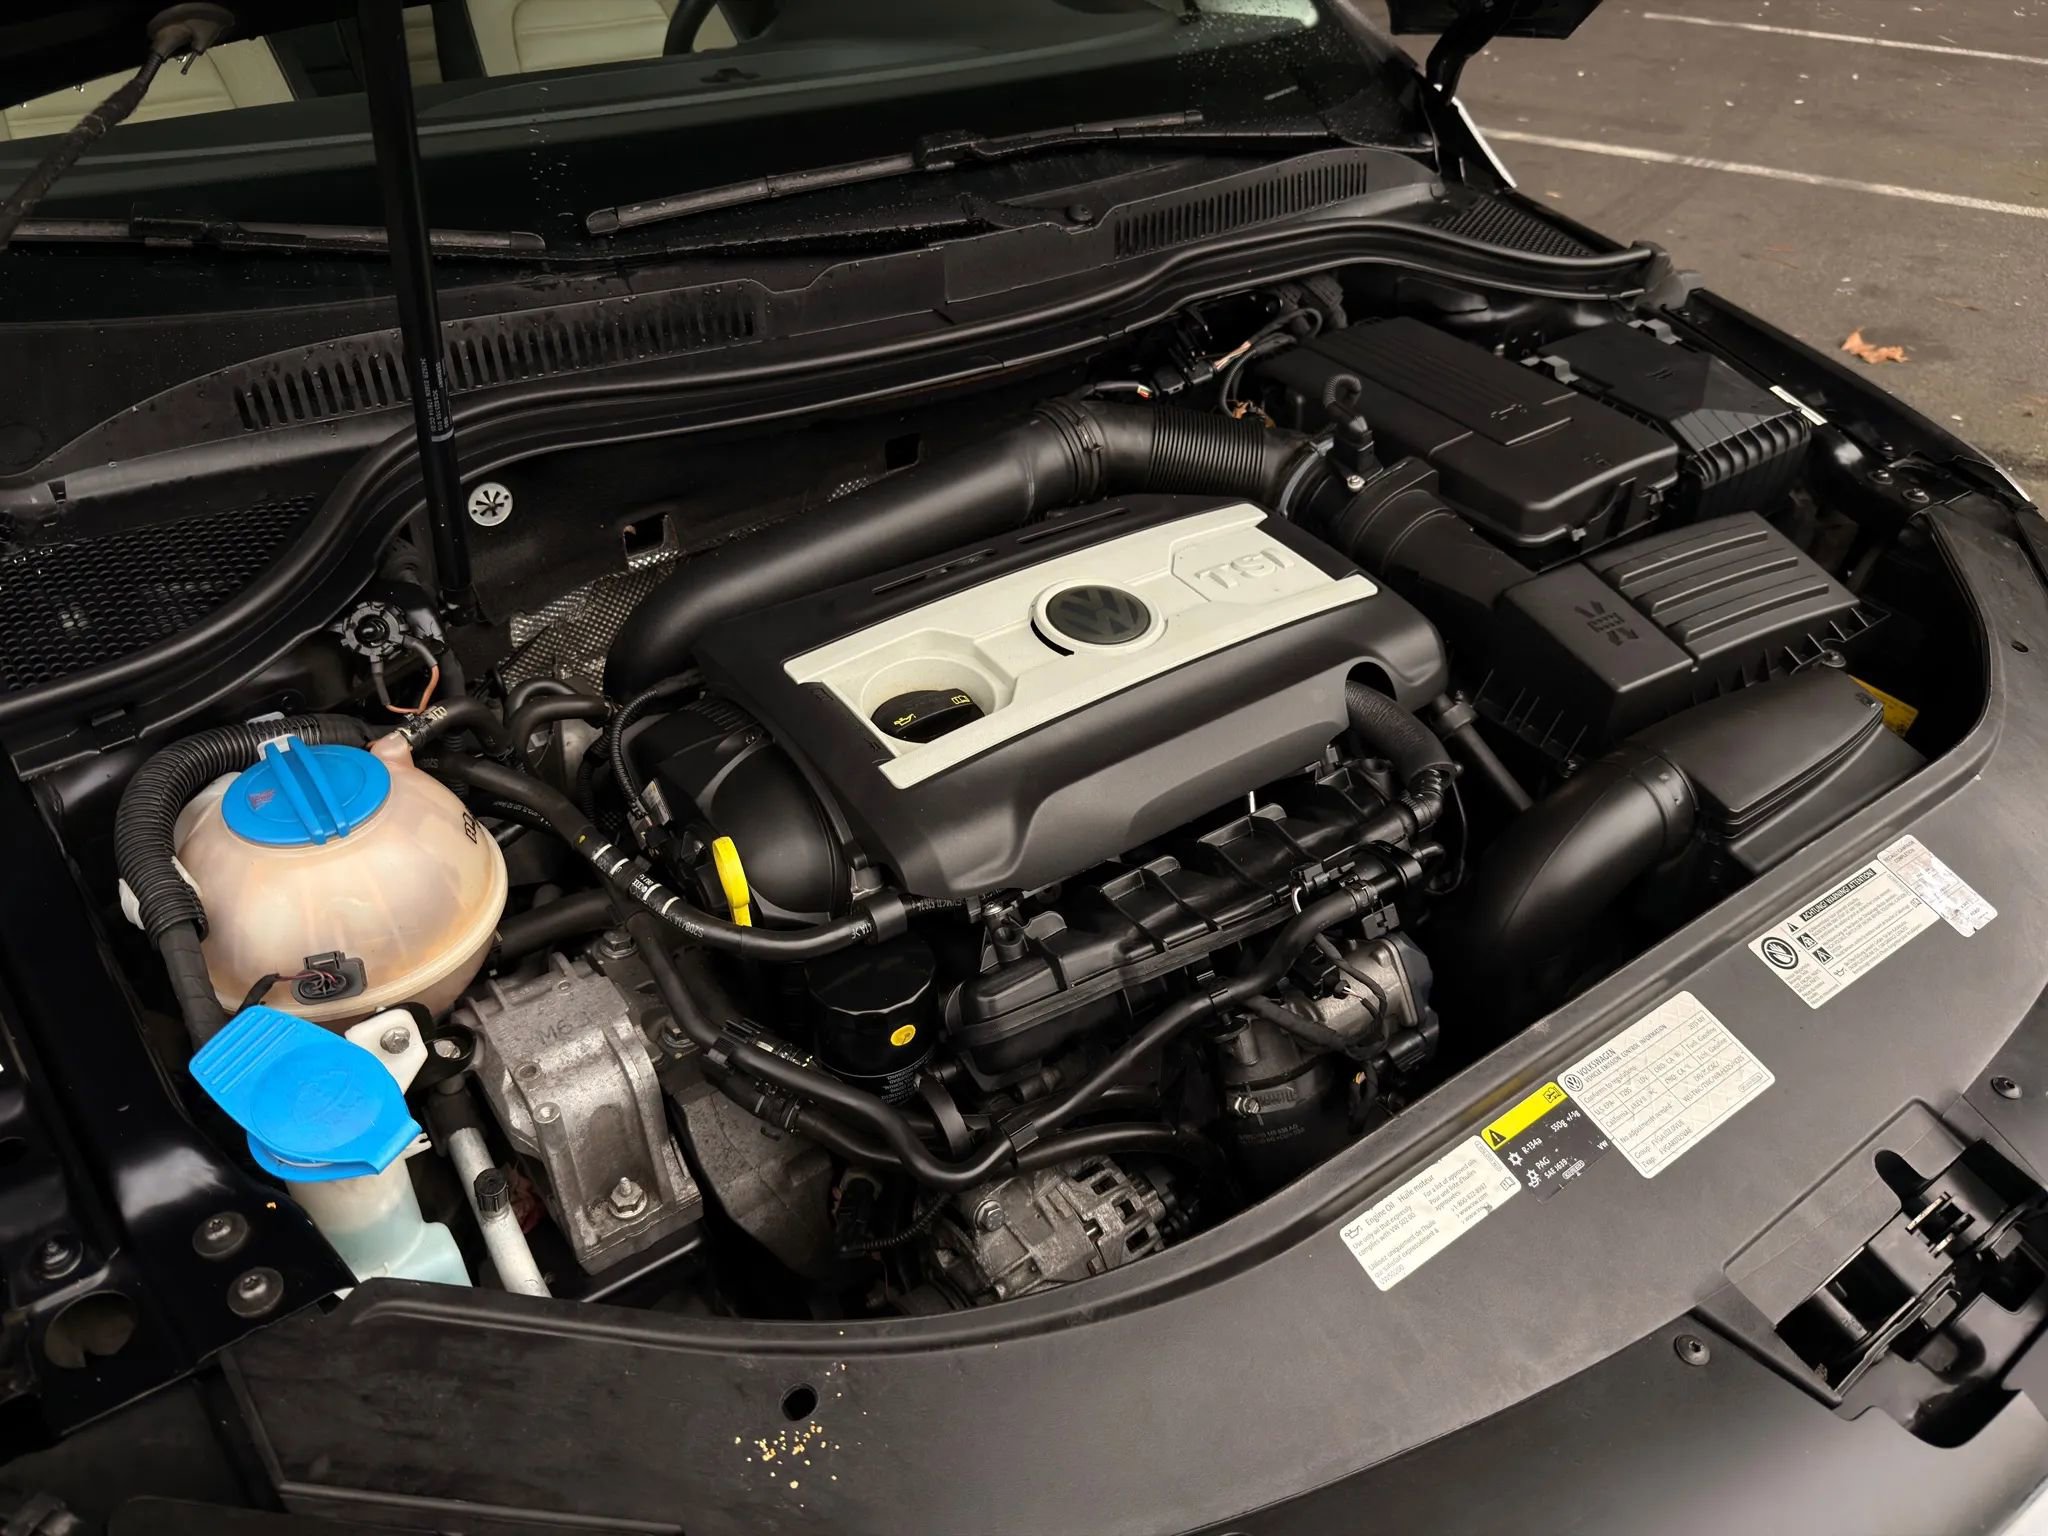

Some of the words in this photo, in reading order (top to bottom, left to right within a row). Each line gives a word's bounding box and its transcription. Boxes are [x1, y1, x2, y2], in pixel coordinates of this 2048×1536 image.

[1193, 547, 1296, 590] TSI
[1803, 901, 1828, 920] ACHTUNG!
[1825, 886, 1850, 904] WARNING!
[1848, 869, 1874, 889] ATTENTION!
[1576, 1048, 1616, 1076] VOLKSWAGEN
[1584, 1069, 1603, 1083] VEHICLE
[1600, 1055, 1622, 1071] EMISSION
[1620, 1043, 1640, 1058] CONTROL
[1639, 1024, 1667, 1045] INFORMATION
[1521, 1138, 1542, 1154] R-134a
[1550, 1119, 1568, 1132] 550g
[1597, 1140, 1608, 1150] VW
[1535, 1156, 1550, 1170] PAG
[1544, 1167, 1556, 1179] SAE
[1554, 1158, 1568, 1171] J639
[1365, 1209, 1387, 1226] Engine
[1385, 1201, 1395, 1212] Oil
[1397, 1189, 1414, 1203] Huile
[1413, 1175, 1434, 1192] moteur
